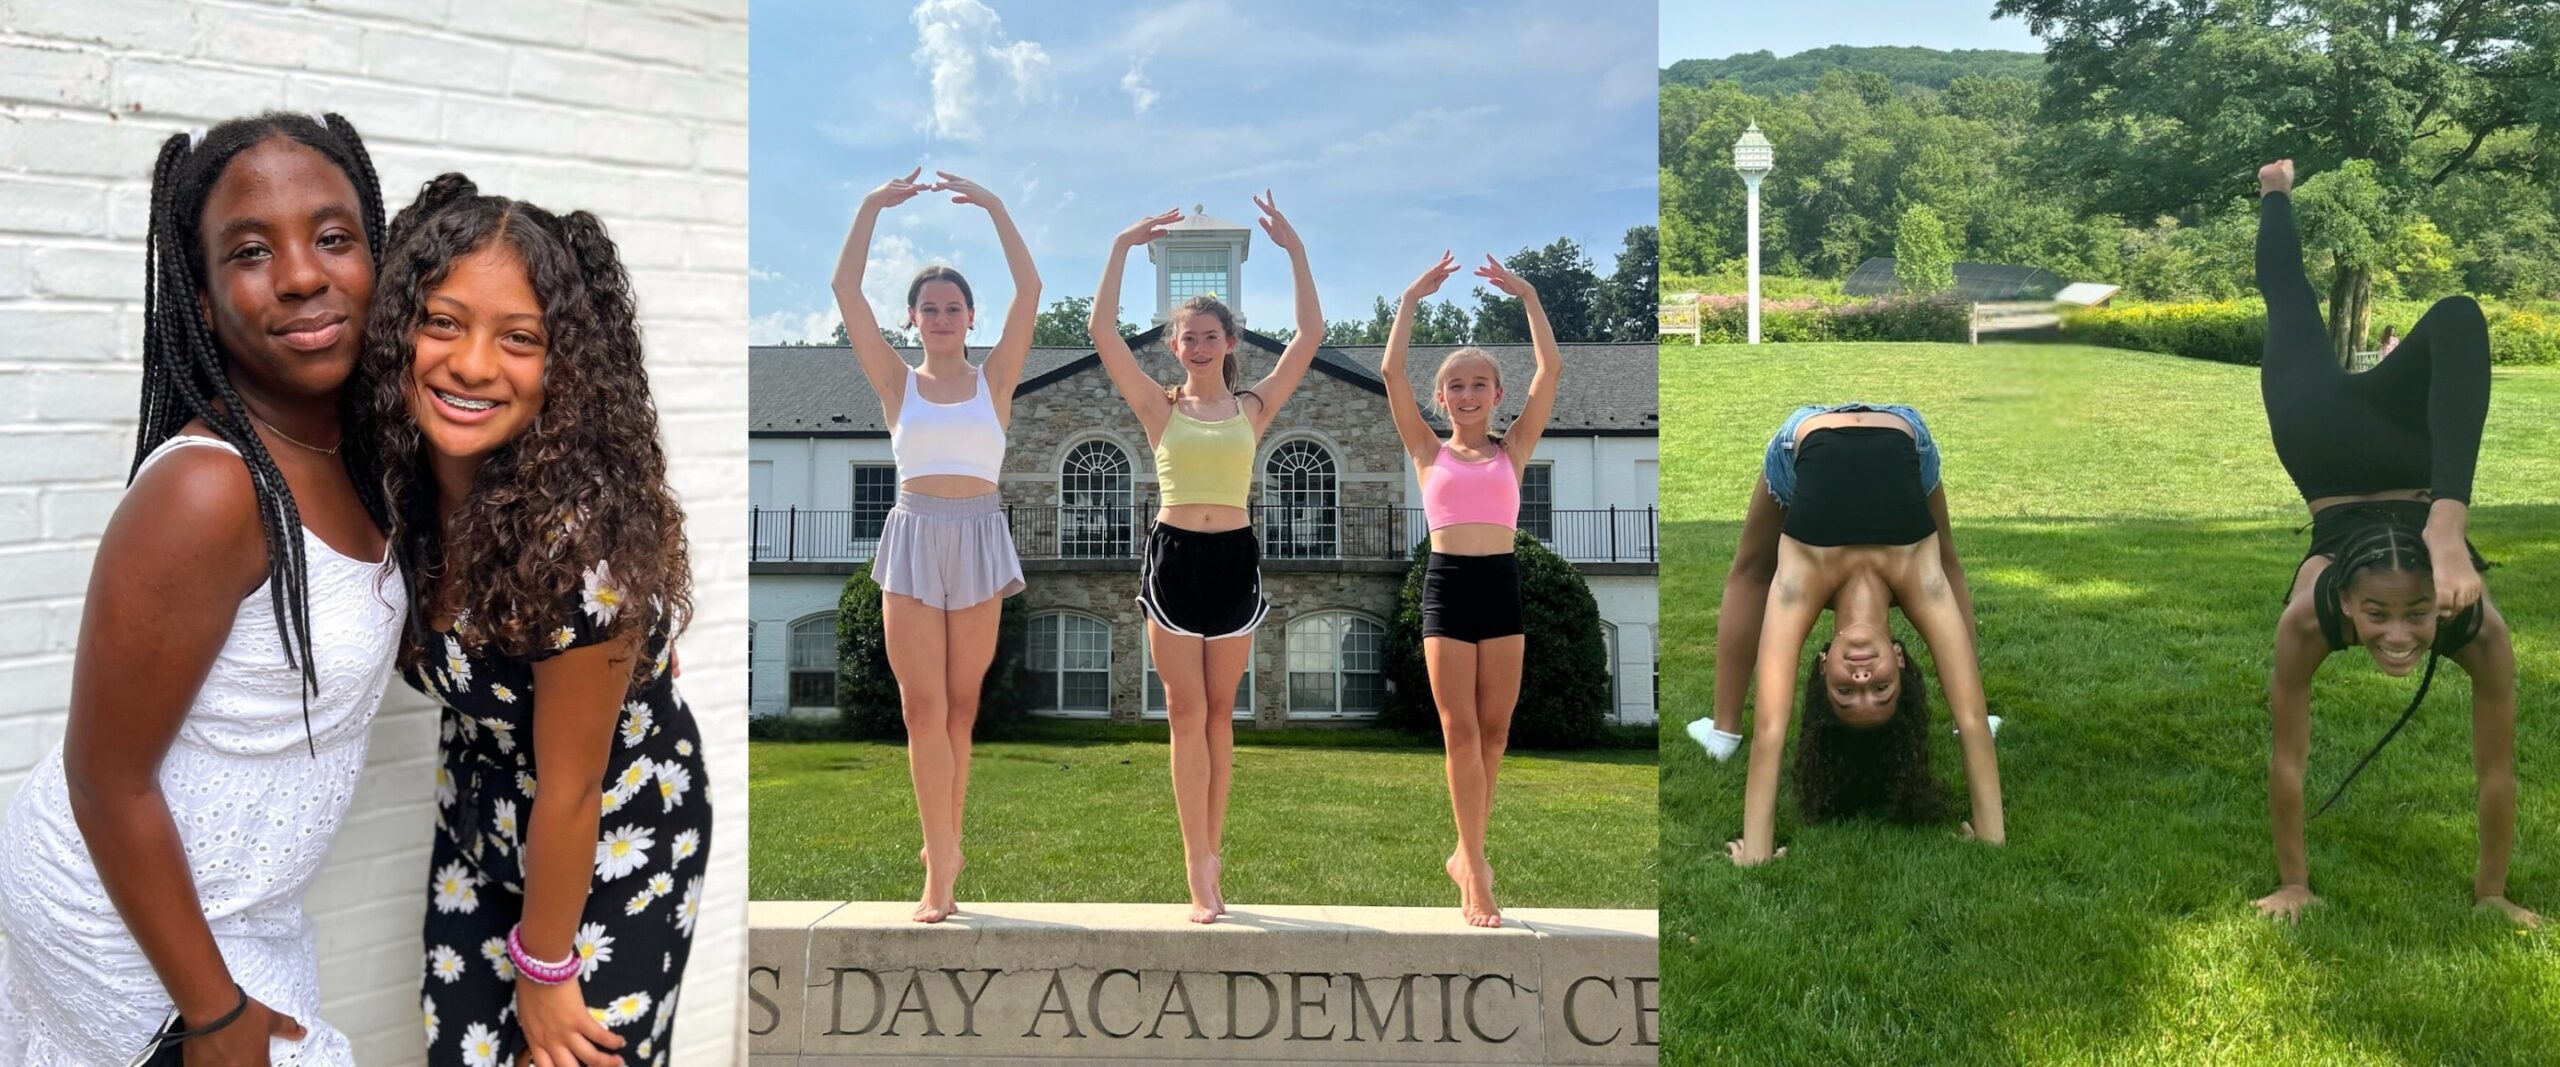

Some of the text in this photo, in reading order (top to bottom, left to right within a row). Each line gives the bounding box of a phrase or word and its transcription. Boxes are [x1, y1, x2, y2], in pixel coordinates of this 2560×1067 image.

[749, 966, 1659, 1046] S DAY ACADEMIC CE
